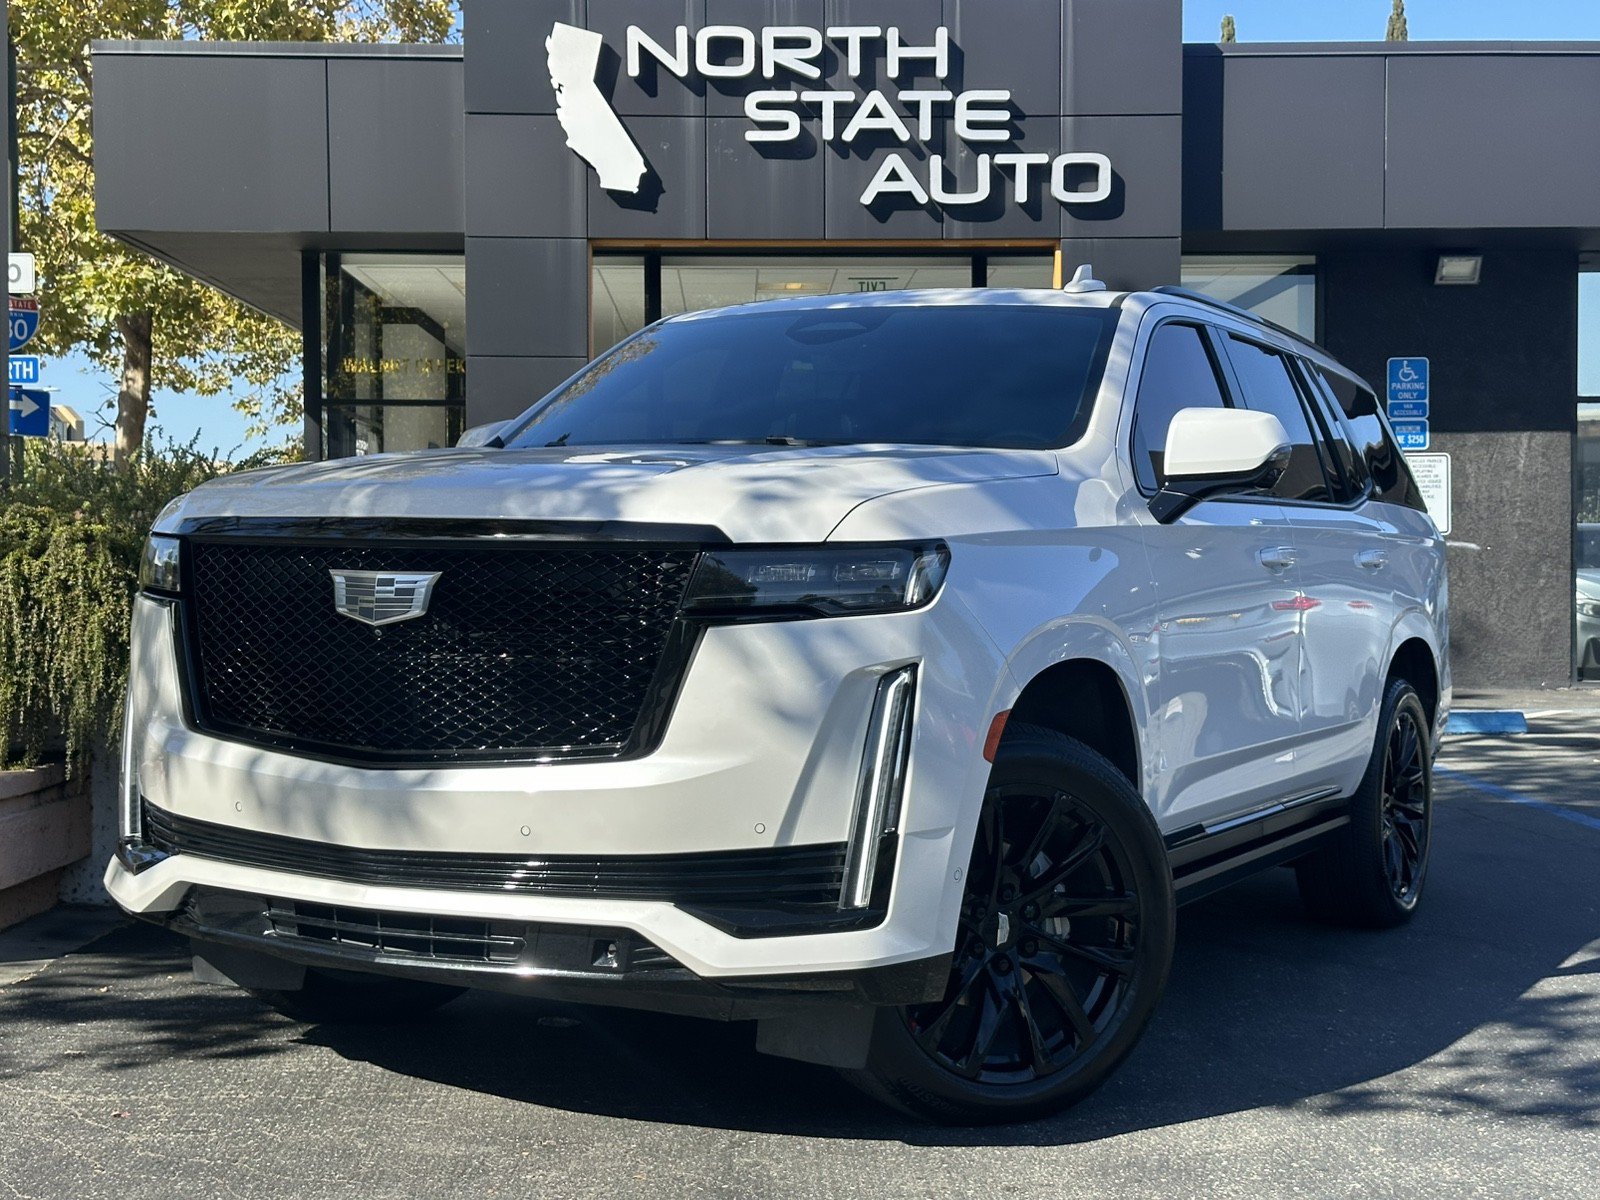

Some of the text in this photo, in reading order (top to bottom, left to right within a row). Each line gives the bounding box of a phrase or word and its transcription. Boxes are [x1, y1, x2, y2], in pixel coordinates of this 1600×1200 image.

[626, 25, 949, 80] NORTH
[743, 89, 1012, 142] STATE
[859, 152, 1113, 206] AUTO
[1391, 382, 1425, 390] PARKING
[1398, 391, 1419, 399] ONLY
[1407, 434, 1424, 444] $250
